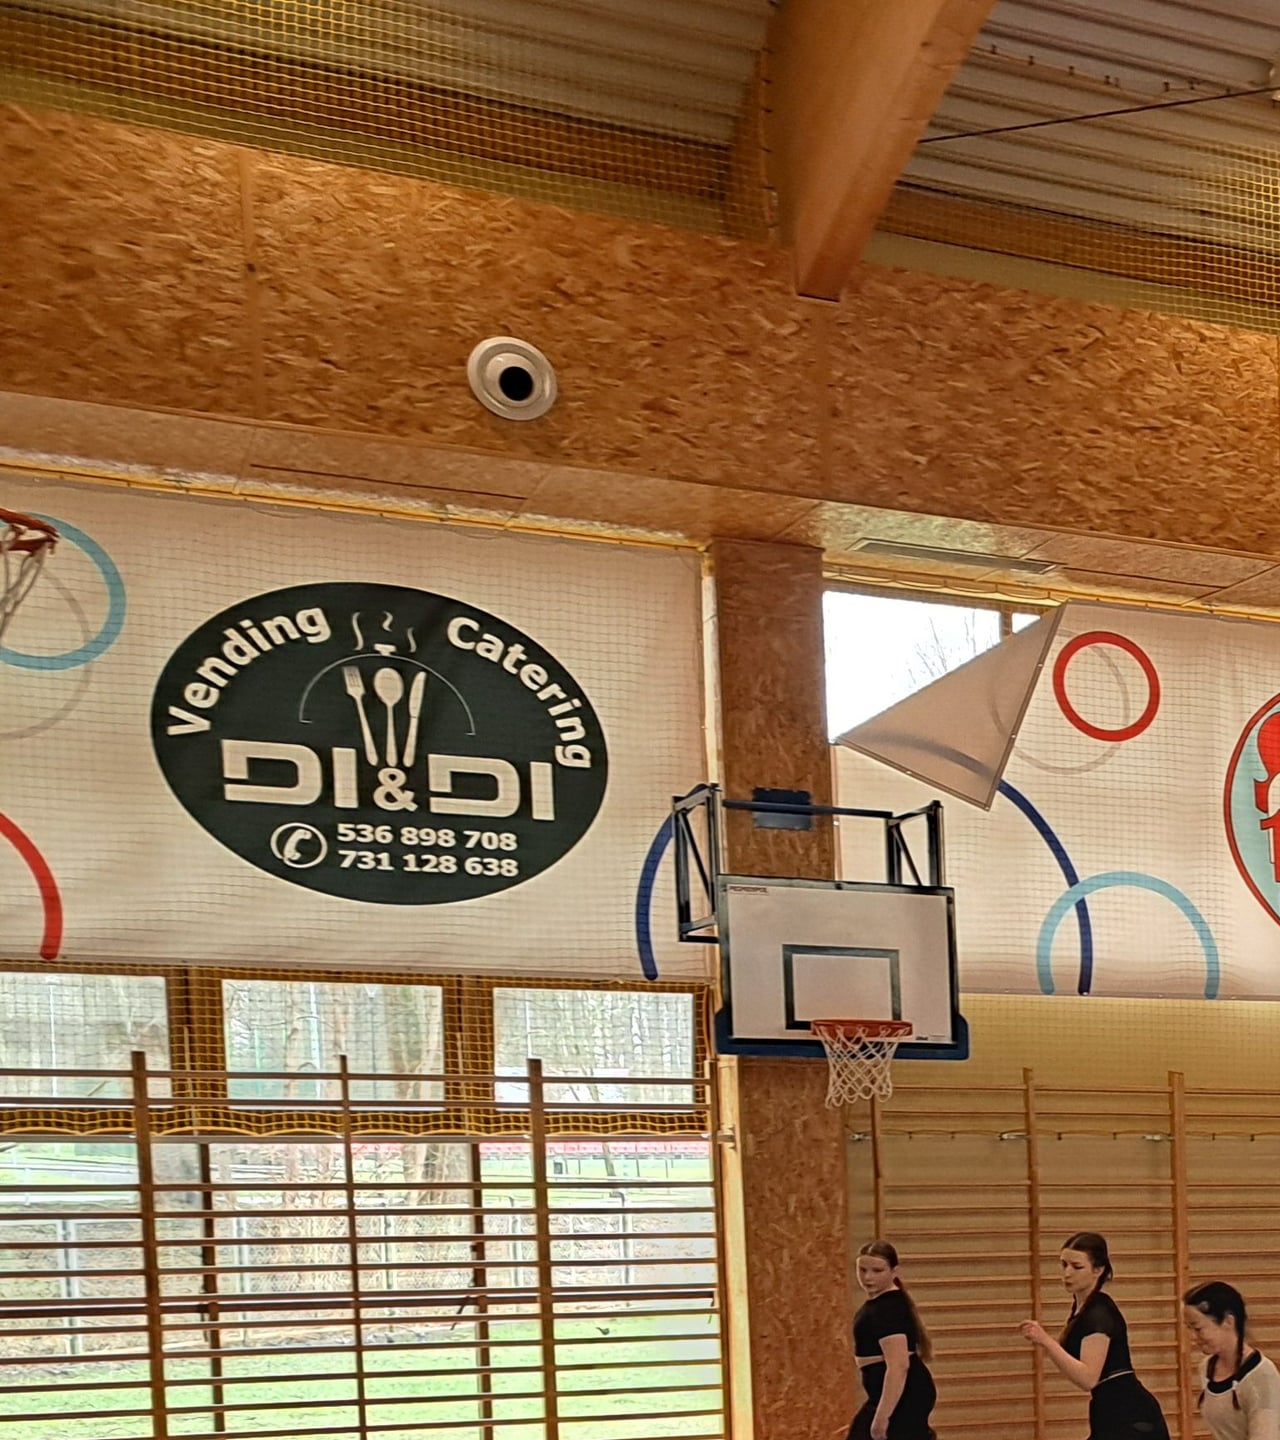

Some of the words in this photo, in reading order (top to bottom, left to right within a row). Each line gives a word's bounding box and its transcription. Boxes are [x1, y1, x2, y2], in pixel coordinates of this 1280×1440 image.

[167, 607, 332, 737] Vending
[447, 616, 592, 769] Catering
[336, 823, 394, 845] 536
[400, 826, 456, 848] 898
[463, 829, 518, 852] 708
[338, 850, 395, 872] 731
[402, 853, 459, 875] 128
[469, 856, 520, 878] 638
